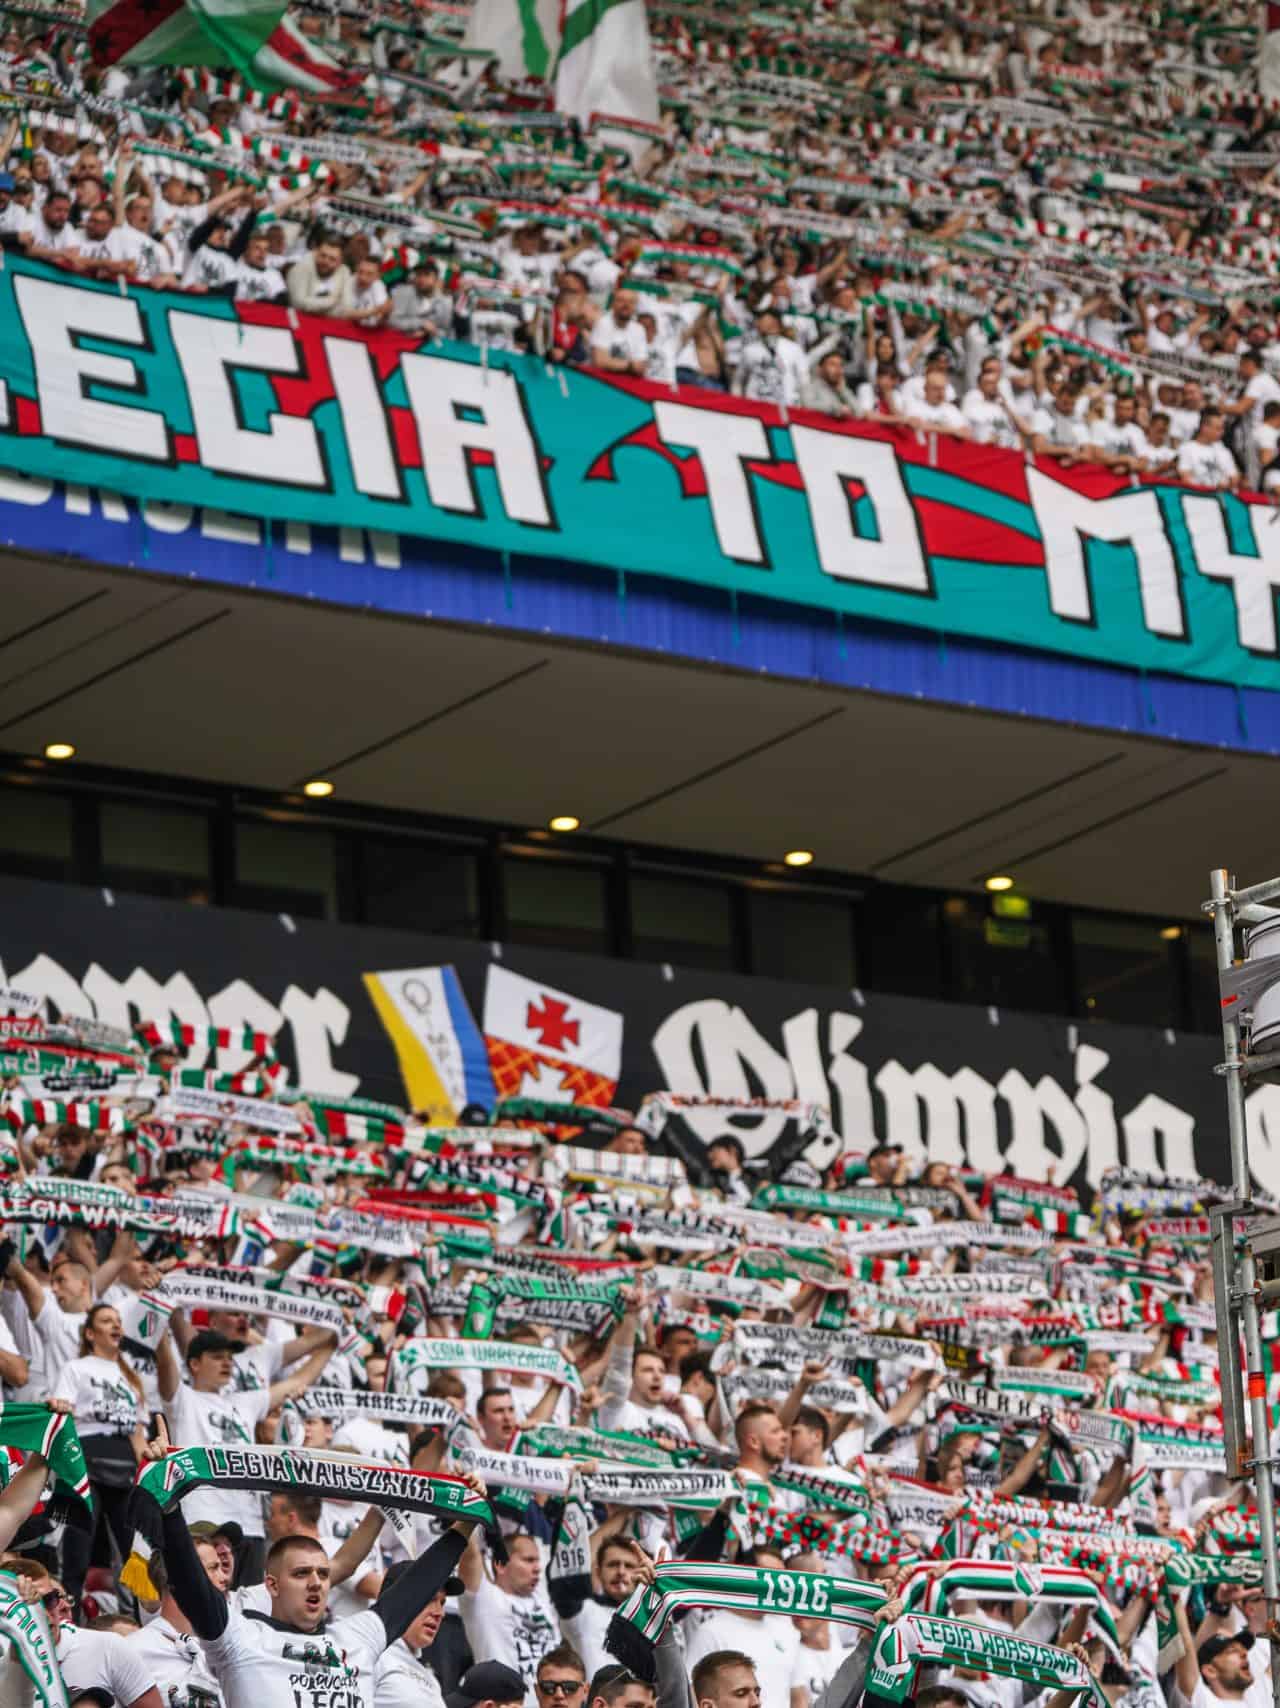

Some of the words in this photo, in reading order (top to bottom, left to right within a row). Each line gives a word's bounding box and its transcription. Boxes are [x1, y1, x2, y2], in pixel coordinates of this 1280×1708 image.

[0, 275, 555, 527] EGIA
[655, 401, 931, 592] TO
[205, 1447, 291, 1482] LEGIA
[292, 1457, 435, 1502] WARSZAWA
[554, 1548, 586, 1569] 1916
[761, 1571, 830, 1613] 1916
[915, 1618, 975, 1651] LEGIA
[979, 1631, 1079, 1678] WARSZAWA
